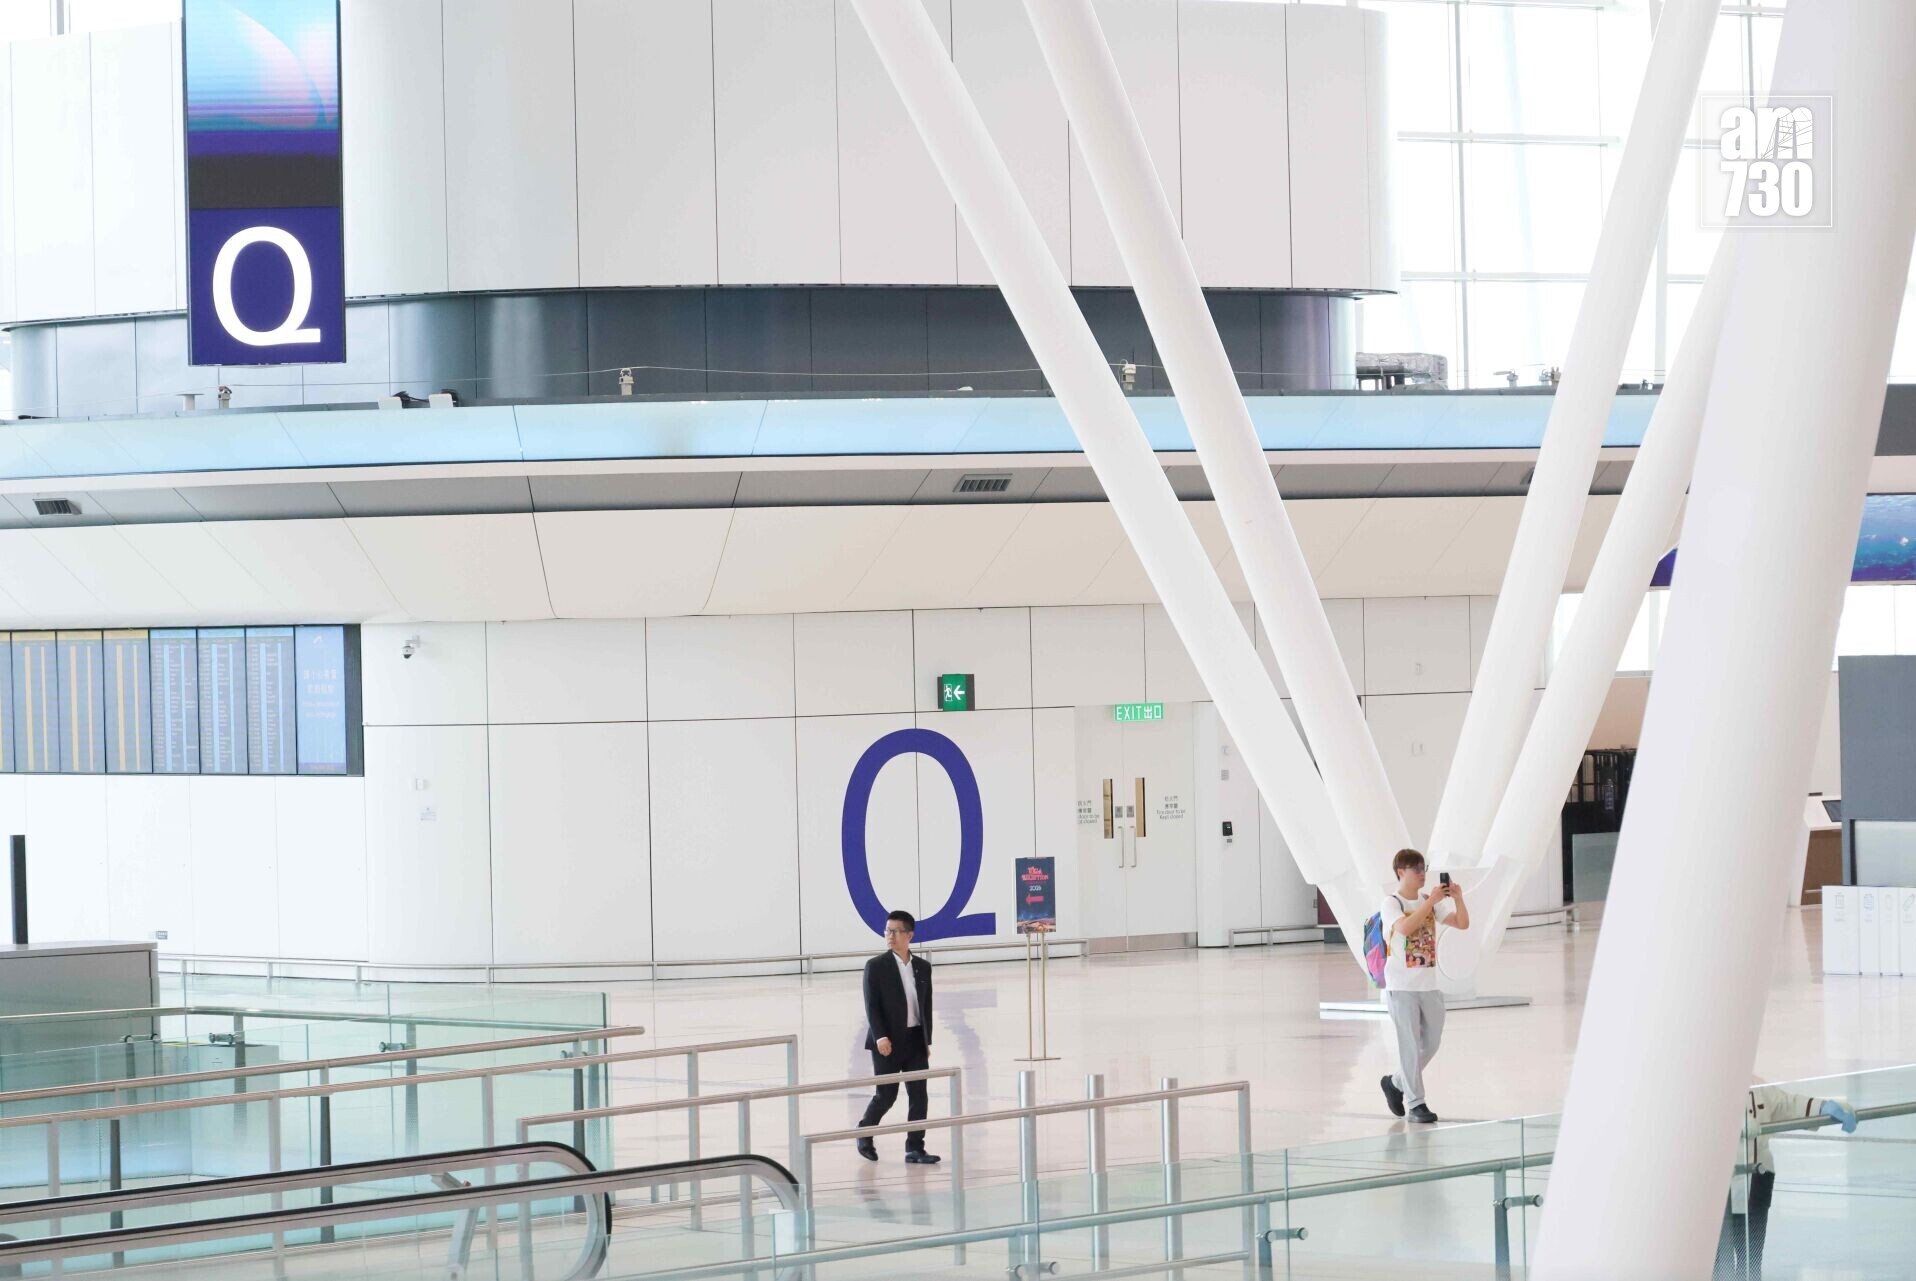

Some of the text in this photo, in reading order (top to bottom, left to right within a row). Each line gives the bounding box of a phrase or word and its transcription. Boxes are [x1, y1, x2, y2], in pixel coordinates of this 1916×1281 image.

[212, 225, 321, 346] Q
[1116, 704, 1162, 720] EXIT 出口
[841, 728, 996, 944] Q
